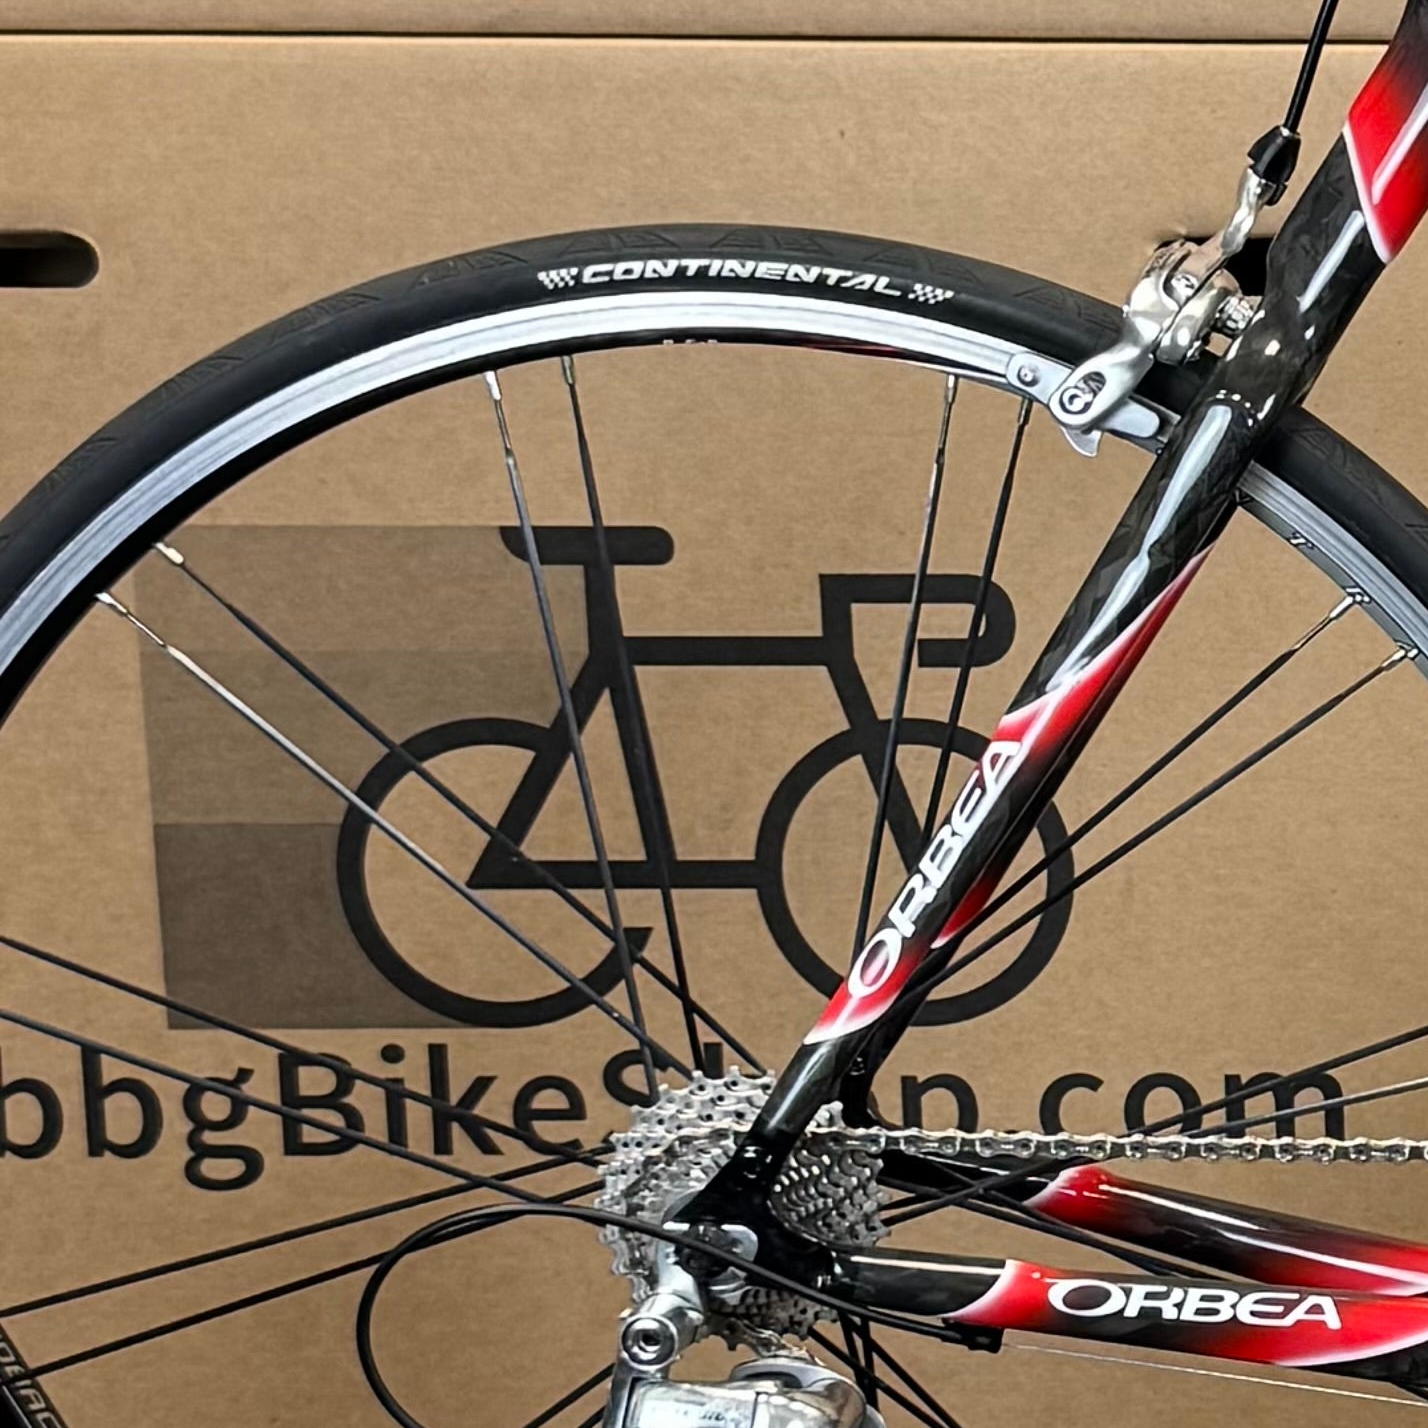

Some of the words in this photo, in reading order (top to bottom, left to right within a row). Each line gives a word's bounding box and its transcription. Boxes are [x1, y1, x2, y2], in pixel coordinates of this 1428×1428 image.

[581, 258, 902, 298] CONTINENTAL
[847, 740, 1022, 999] ORBEA
[1047, 1276, 1343, 1332] ORBEA
